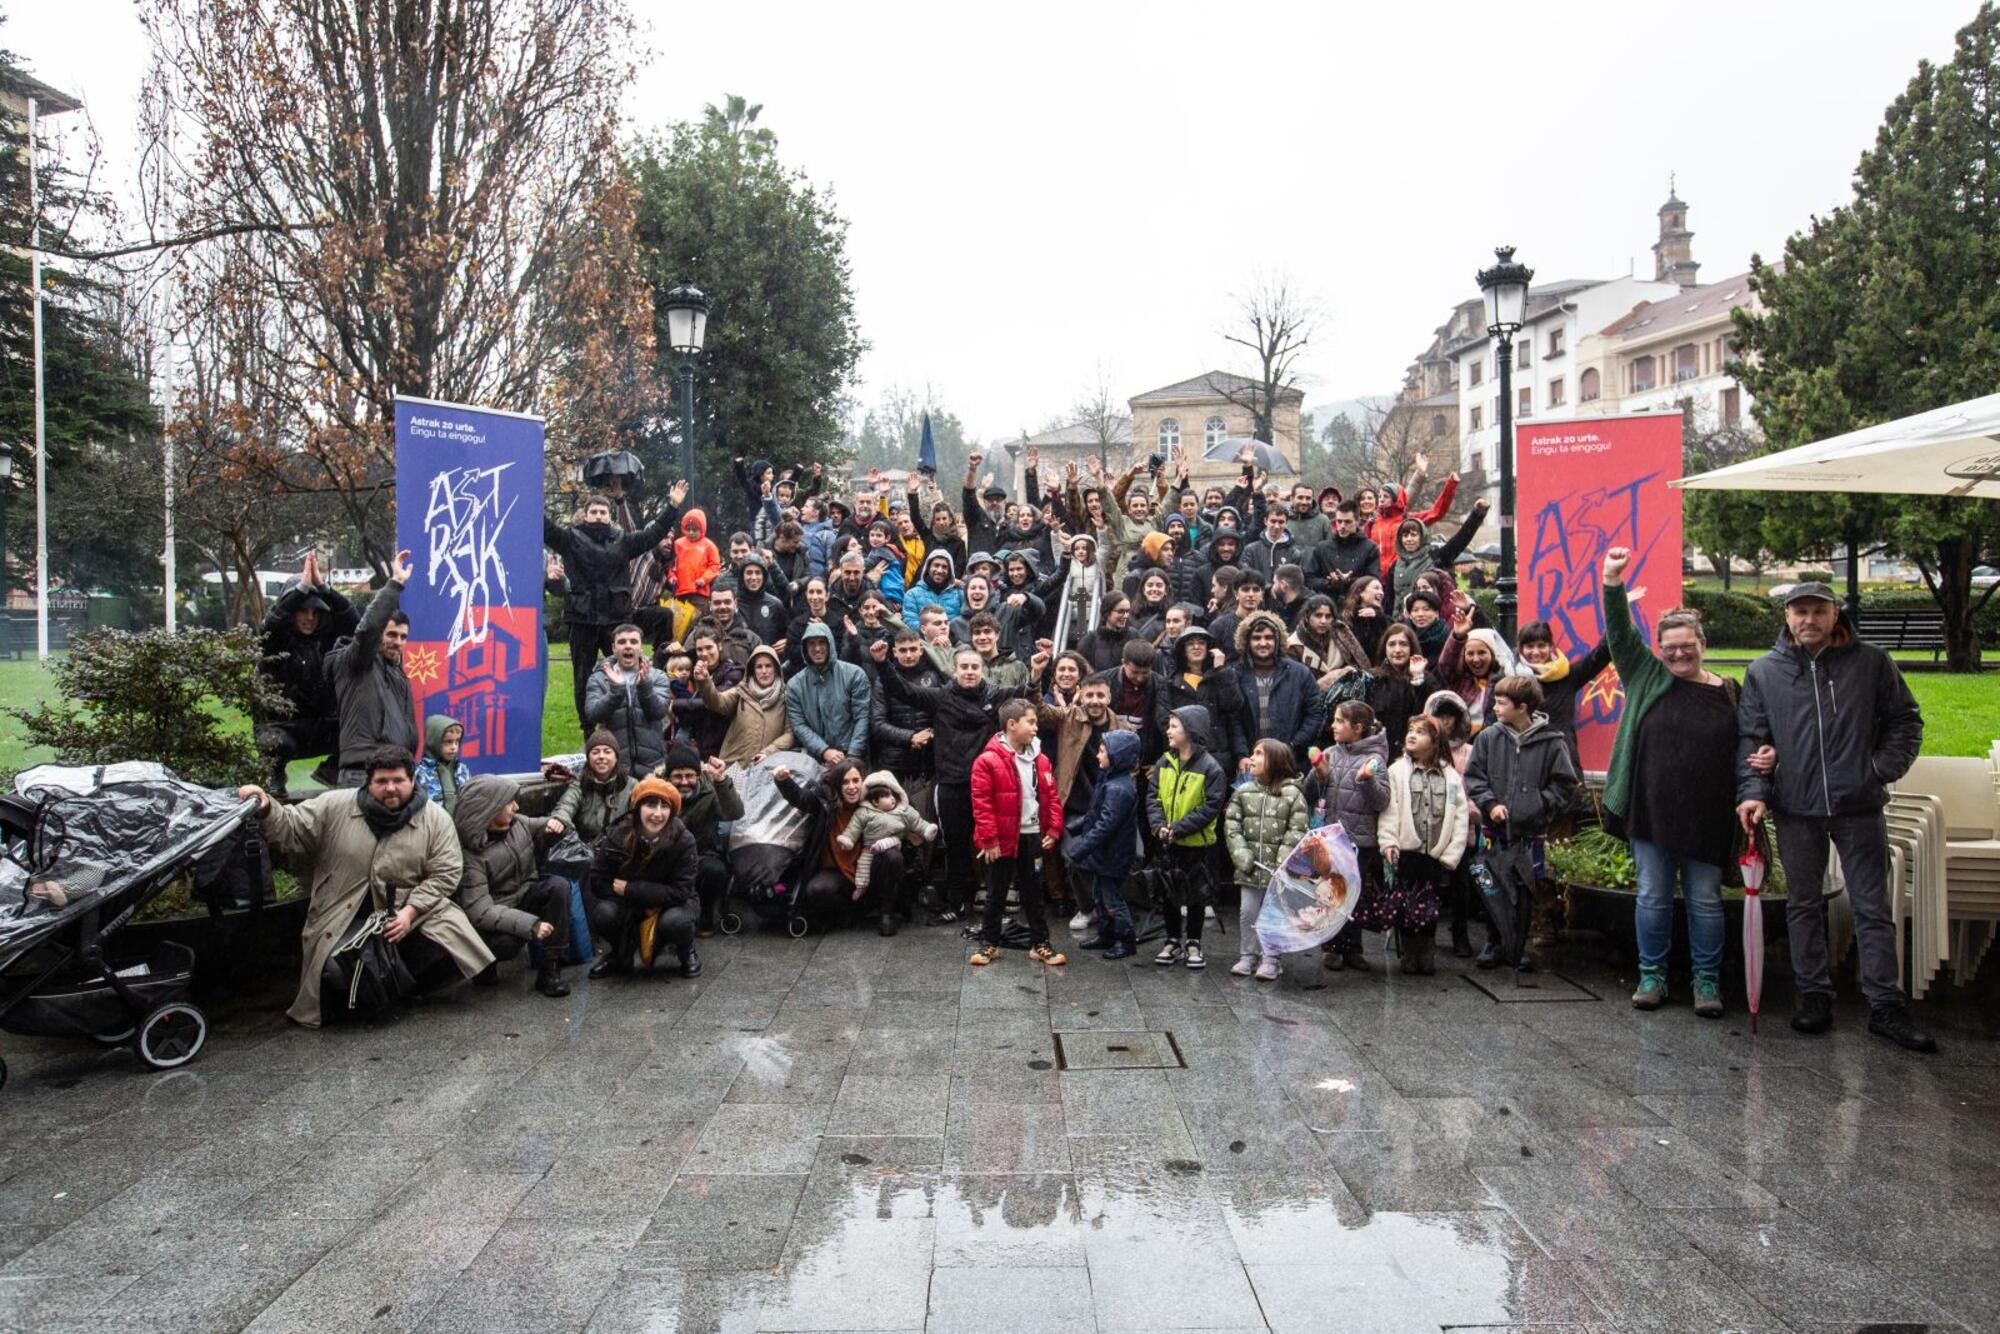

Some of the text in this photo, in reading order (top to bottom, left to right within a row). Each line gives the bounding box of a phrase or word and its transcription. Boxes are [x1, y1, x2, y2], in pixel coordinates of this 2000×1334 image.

[410, 416, 476, 433] Astrak 20 urte.
[410, 426, 487, 444] Eingu ta eingogu!
[1531, 433, 1600, 446] Astrak 20 urte.
[1531, 441, 1612, 455] Eingu ta eingogu!
[424, 462, 516, 536] AST
[445, 577, 490, 657] 20
